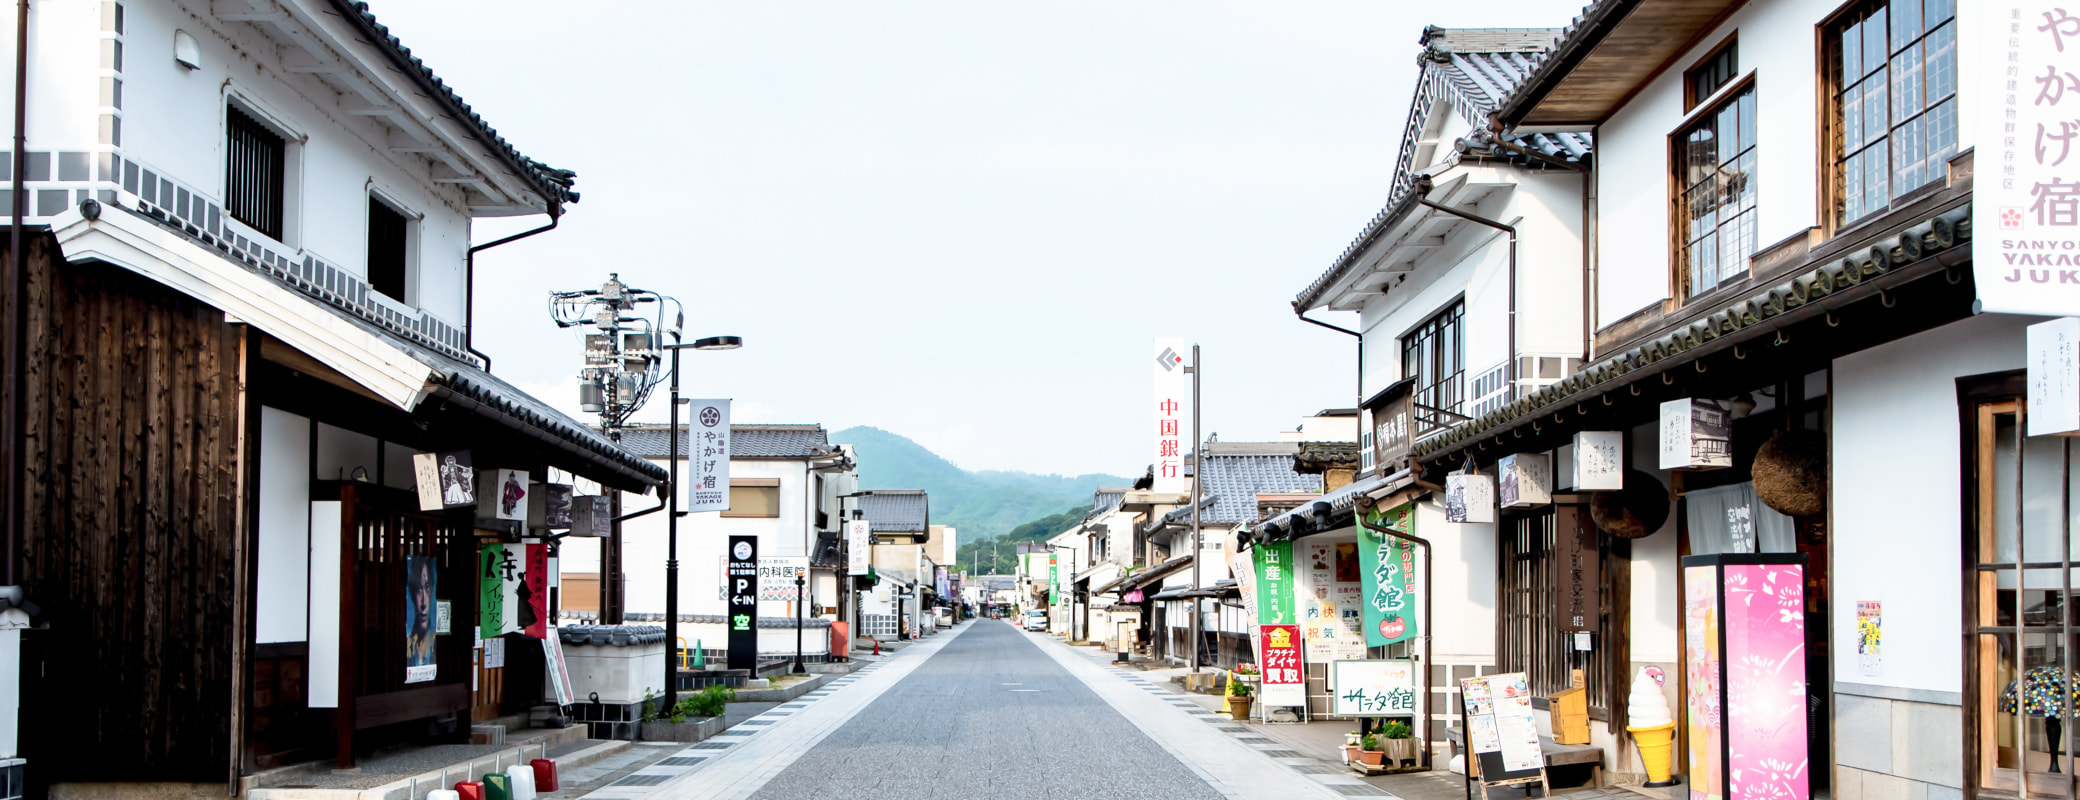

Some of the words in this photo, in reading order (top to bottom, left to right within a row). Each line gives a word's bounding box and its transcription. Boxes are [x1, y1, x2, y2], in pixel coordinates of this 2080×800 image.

[2002, 8, 2021, 190] 重要伝統的建造物群保存地区
[2029, 7, 2080, 226] やかげ宿
[2001, 239, 2080, 250] SANYO
[1160, 398, 1178, 478] 中国銀行
[703, 431, 717, 489] やかげ宿
[485, 548, 517, 582] 侍
[759, 566, 806, 578] 内科医院
[1265, 549, 1281, 581] 出産
[1373, 515, 1405, 612] サラダ館
[736, 579, 748, 594] P
[487, 583, 508, 632] イタリアン
[743, 596, 754, 605] IN
[734, 613, 750, 630] 空
[1267, 649, 1296, 657] プラチナ
[1267, 657, 1297, 668] ダイヤ
[1266, 668, 1299, 683] 買取
